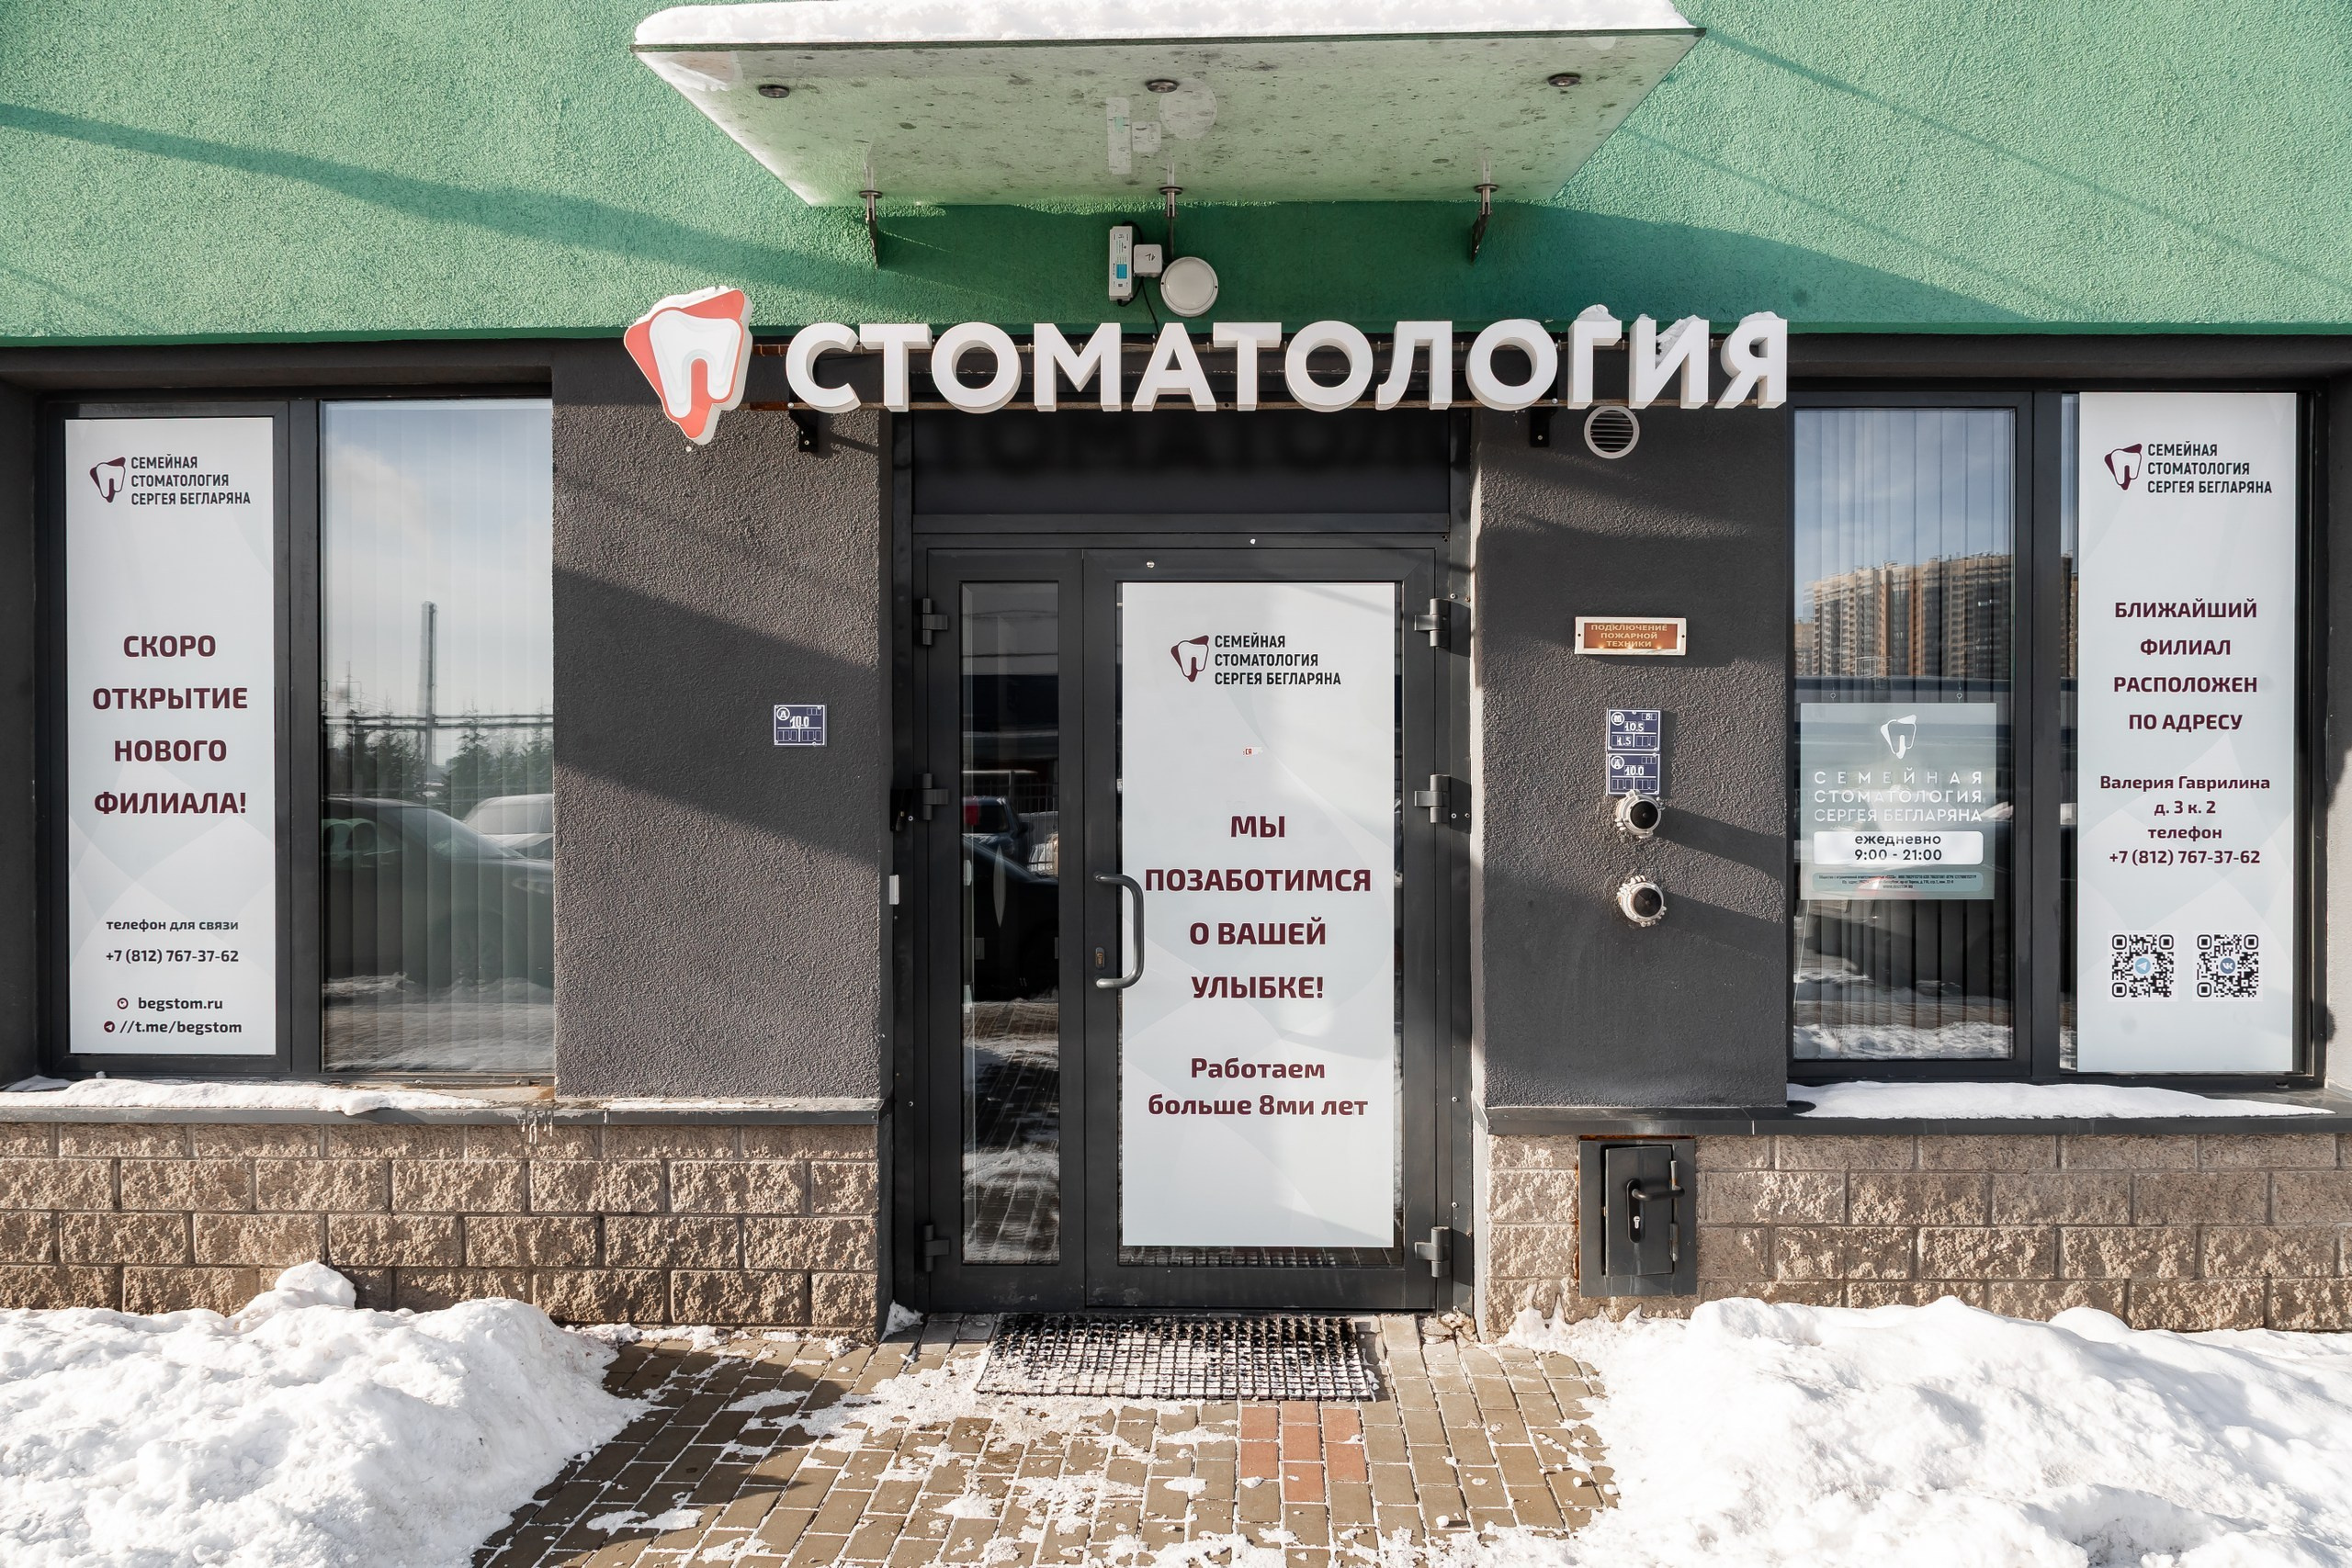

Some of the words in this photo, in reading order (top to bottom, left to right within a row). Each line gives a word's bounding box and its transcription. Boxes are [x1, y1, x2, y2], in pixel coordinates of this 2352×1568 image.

[786, 317, 1788, 413] СТОМАТОЛОГИЯ
[2147, 440, 2218, 457] СЕМЕЙНАЯ
[130, 453, 198, 469] СЕМЕЙНАЯ
[2147, 461, 2250, 475] СТОМАТОЛОГИЯ
[130, 474, 229, 488] СТОМАТОЛОГИЯ
[2147, 480, 2195, 493] СЕРГЕЯ
[2199, 480, 2273, 494] БЕГЛАРЯНА
[130, 492, 176, 505] СЕРГЕЯ
[180, 491, 251, 505] БЕГЛАРЯНА
[2115, 597, 2257, 618] БЛИЖАЙШИЙ
[123, 635, 216, 658] СКОРО
[1215, 632, 1285, 649] СЕМЕЙНАЯ
[2140, 638, 2231, 656] ФИЛИАЛ
[1215, 653, 1318, 667] СТОМАТОЛОГИЯ
[1215, 671, 1262, 685] СЕРГЕЯ
[1266, 671, 1341, 685] БЕГЛАРЯНА
[2114, 676, 2257, 693] РАСПОЛОЖЕН
[92, 687, 248, 710] ОТКРЫТИЕ
[790, 716, 809, 728] 10.0
[1624, 722, 1645, 731] 10.5
[2129, 714, 2157, 730] ПО
[2162, 714, 2243, 733] АДРЕСУ
[1617, 736, 1631, 746] 1.5
[114, 739, 227, 762] НОВОГО
[1624, 766, 1645, 776] 10.0
[1814, 767, 1983, 784] СЕМЕЙНАЯ
[2100, 775, 2174, 793] Валерия
[2178, 775, 2270, 793] Гаврилина
[94, 791, 246, 815] ФИЛИАЛА!
[1814, 790, 1983, 803] СТОМАТОЛОГИЯ
[1814, 809, 1878, 822] СЕРГЕЯ
[1883, 809, 1983, 822] БЕГЛАРЯНА
[2154, 804, 2170, 817] д.
[2174, 800, 2184, 814] 3
[2188, 804, 2202, 814] к.
[2206, 800, 2216, 814] 2
[1230, 815, 1285, 838] МЫ
[2147, 825, 2222, 842] телефон
[1854, 835, 1941, 847] ежедневно
[1854, 849, 1888, 861] 9:00
[1903, 849, 1942, 861] 21:00
[2109, 850, 2129, 864] +7
[2132, 849, 2174, 866] (812)
[2177, 850, 2260, 864] 767-37-62
[1145, 868, 1371, 892] ПОЗАБОТИМСЯ
[106, 919, 166, 932] телефон
[169, 921, 196, 932] для
[198, 921, 239, 931] связи
[1189, 922, 1209, 945] О
[1217, 916, 1326, 945] ВАШЕЙ
[106, 950, 122, 962] +7
[125, 948, 163, 964] (812)
[165, 950, 239, 963] 767-37-62
[1191, 976, 1324, 998] УЛЫБКЕ!
[138, 997, 223, 1012] begstom.ru
[119, 1020, 243, 1036] //t.me/begstom
[1191, 1056, 1325, 1079] Работаем
[1148, 1093, 1252, 1115] больше
[1259, 1094, 1315, 1116] 8ми
[1320, 1100, 1369, 1116] лет
